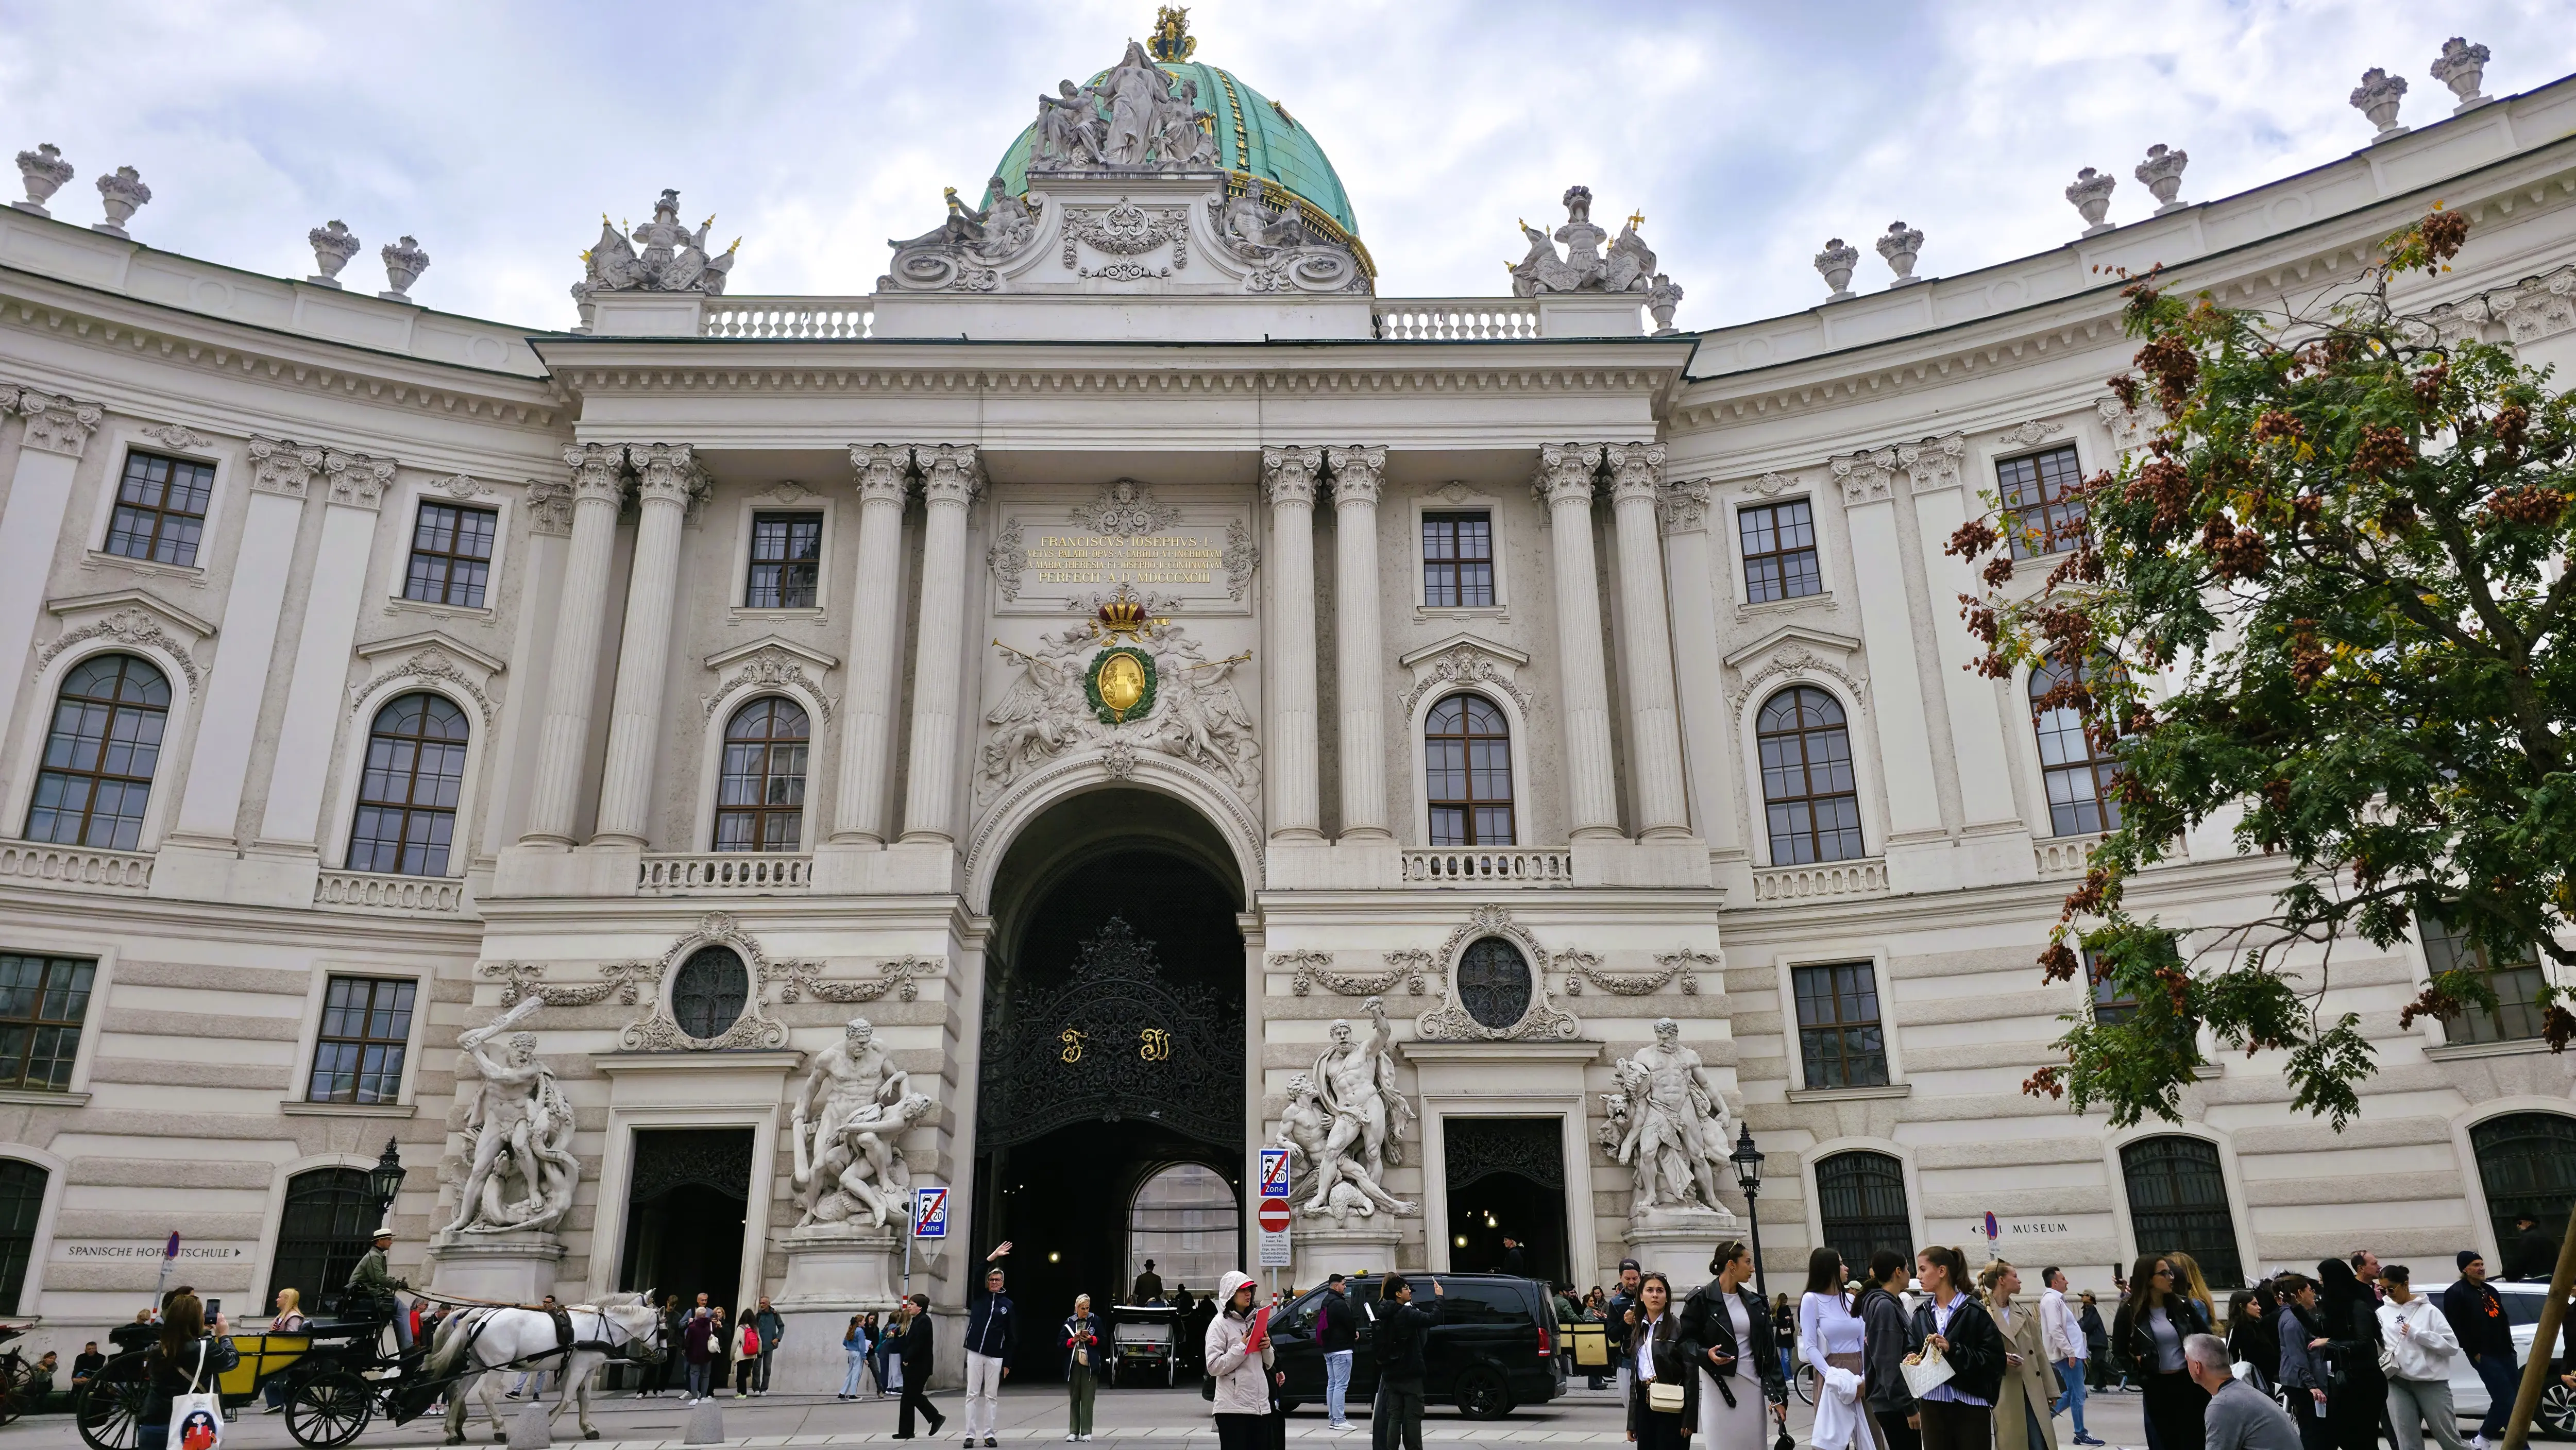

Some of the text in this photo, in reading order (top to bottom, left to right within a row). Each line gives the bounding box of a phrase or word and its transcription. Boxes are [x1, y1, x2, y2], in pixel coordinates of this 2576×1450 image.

[1041, 537, 1124, 547] FRANCISCVS
[1131, 537, 1197, 547] IOSEPHVS
[1027, 550, 1054, 558] VETVS
[1058, 550, 1088, 558] PALATII
[1092, 550, 1114, 558] OPVS
[1116, 550, 1123, 558] A
[1126, 550, 1159, 558] CAROLO
[1175, 550, 1222, 558] INCHOATVM
[1027, 561, 1032, 569] A
[1036, 561, 1062, 569] MARIA
[1064, 561, 1104, 569] THERESIA
[1039, 572, 1210, 583] PERFECIT A D MDCCCXCIII
[1276, 1173, 1285, 1181] 20
[933, 1212, 942, 1220] 20
[1980, 1223, 2067, 1234] SI MUSEUM
[69, 1247, 230, 1257] SPANISCHE HOFTSCHULE
